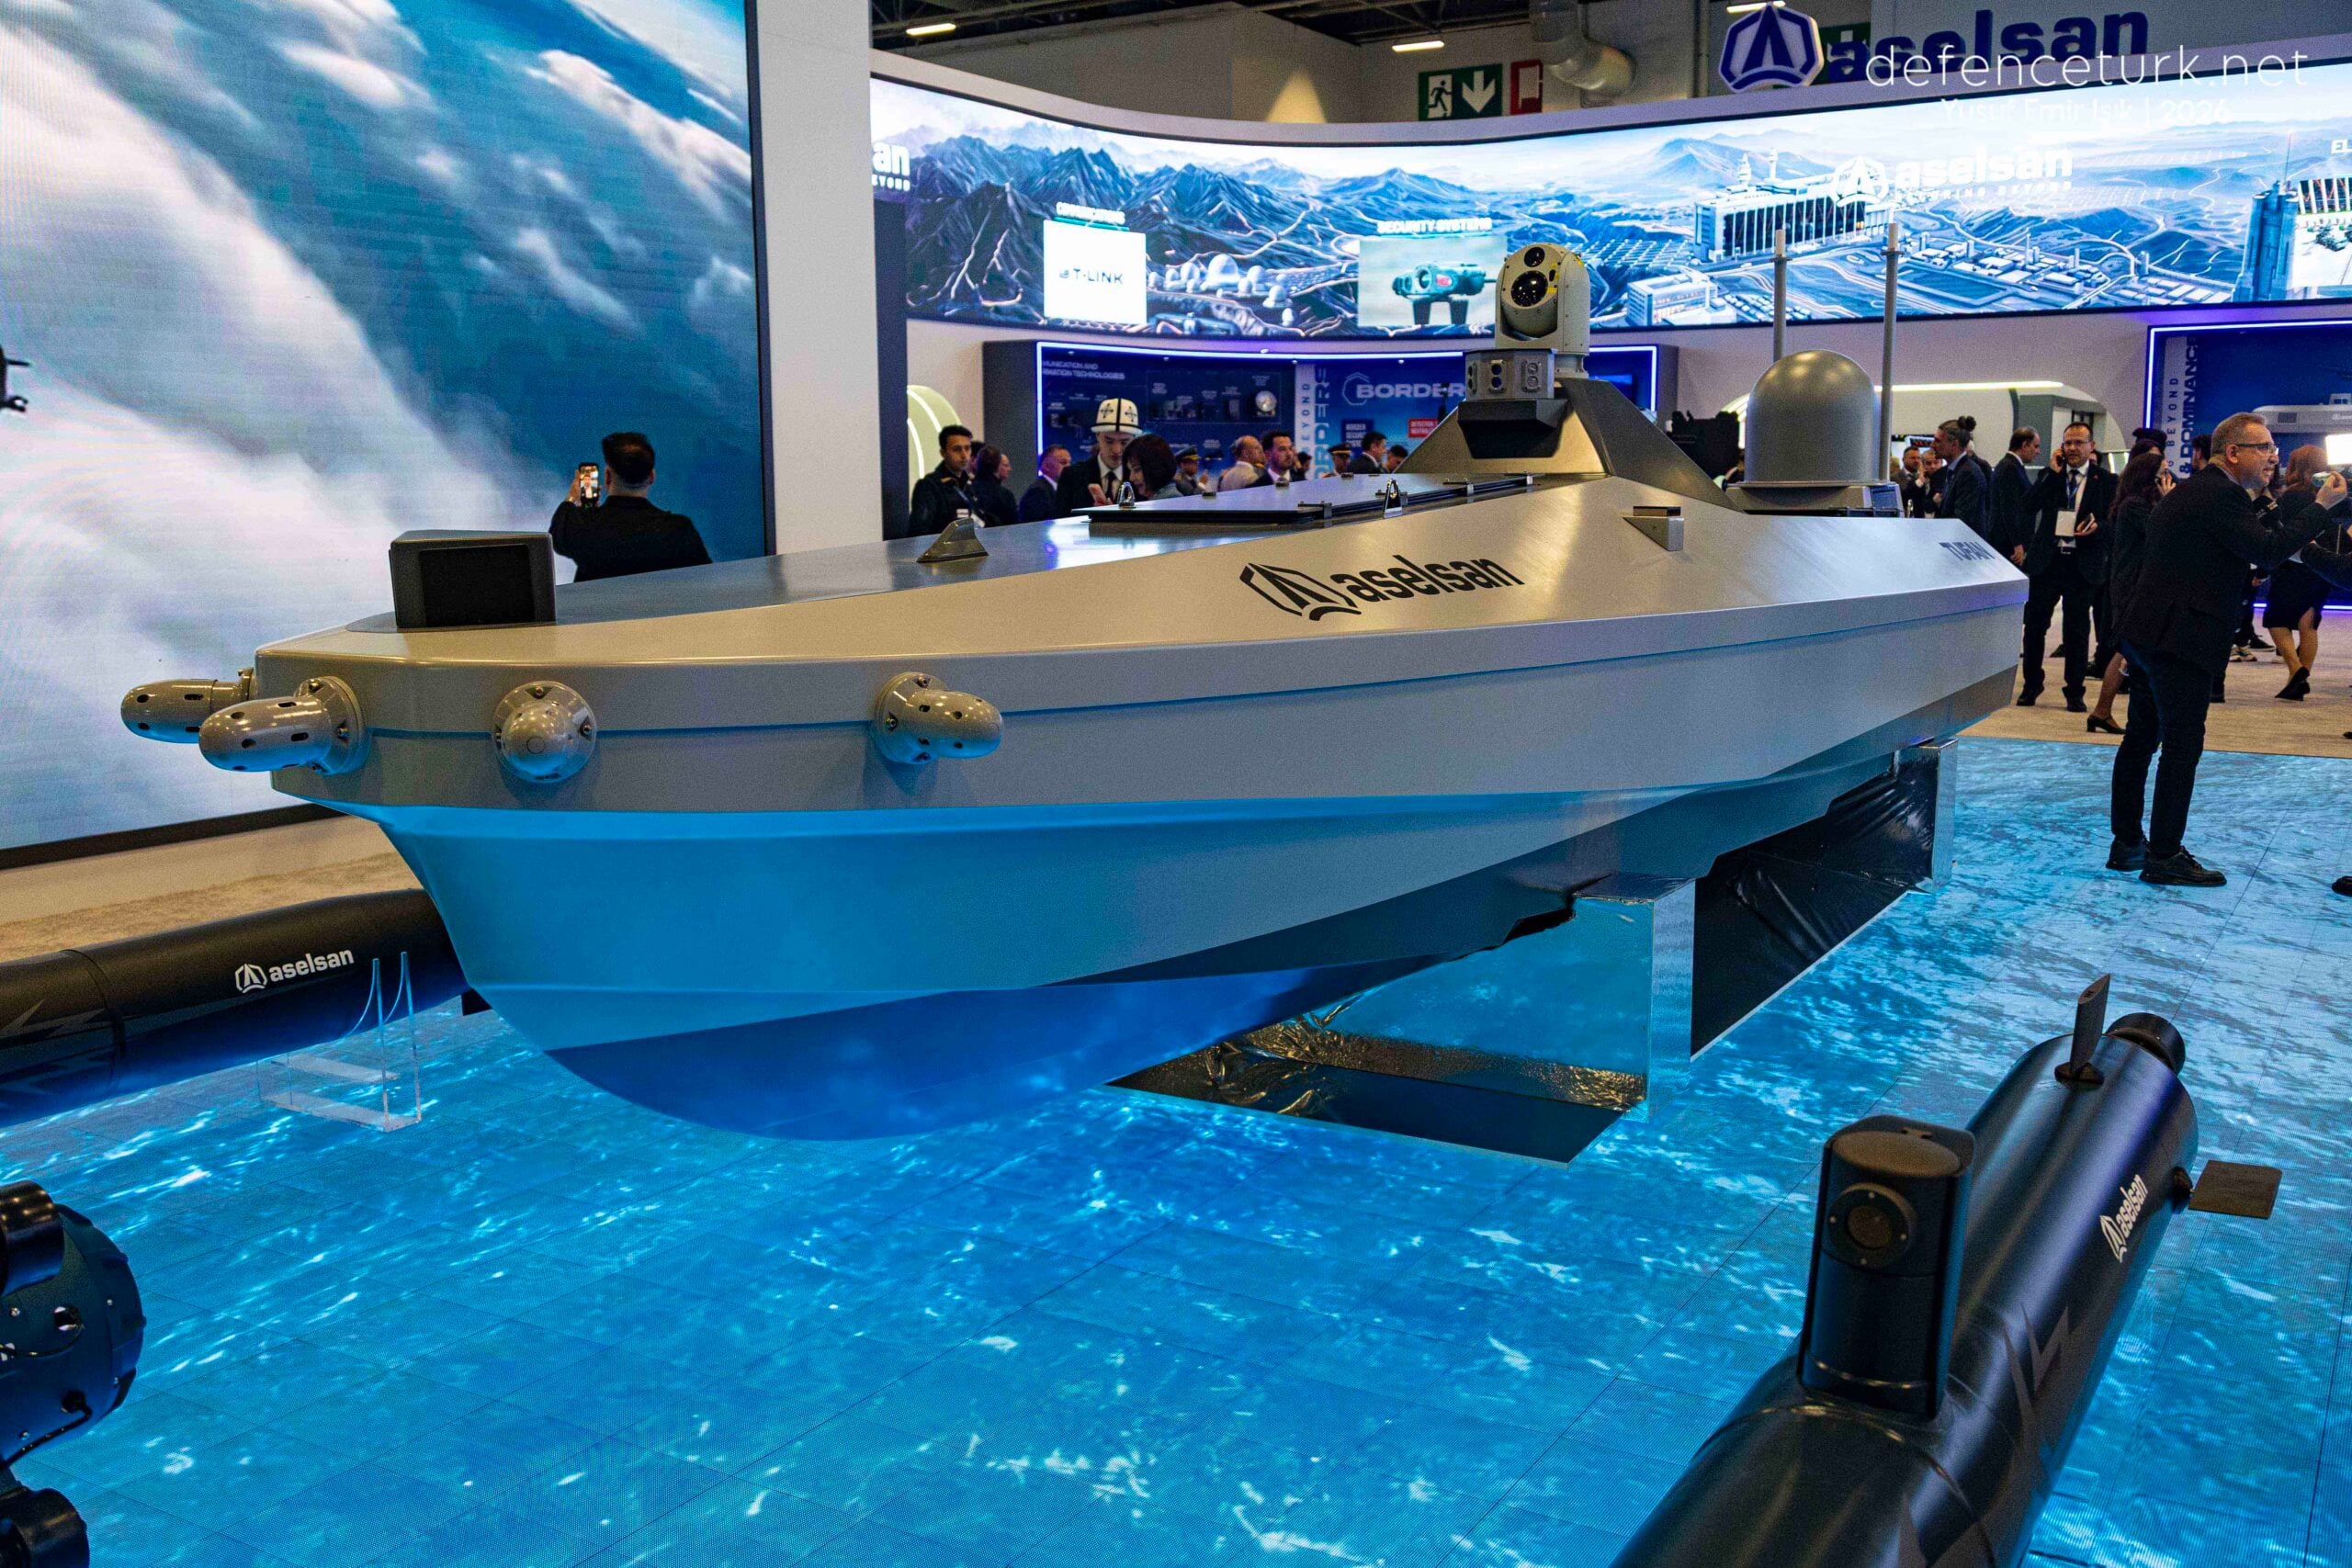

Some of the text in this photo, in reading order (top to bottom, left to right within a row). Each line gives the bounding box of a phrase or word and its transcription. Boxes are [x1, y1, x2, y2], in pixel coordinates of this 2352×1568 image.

[1829, 5, 2148, 84] aselsan
[872, 174, 910, 192] EYOND
[1895, 146, 2074, 186] aselsan
[2166, 378, 2179, 447] BEYOND
[1329, 554, 1525, 603] aselsan
[268, 949, 355, 983] aselsan
[2115, 1174, 2149, 1239] aselsan
